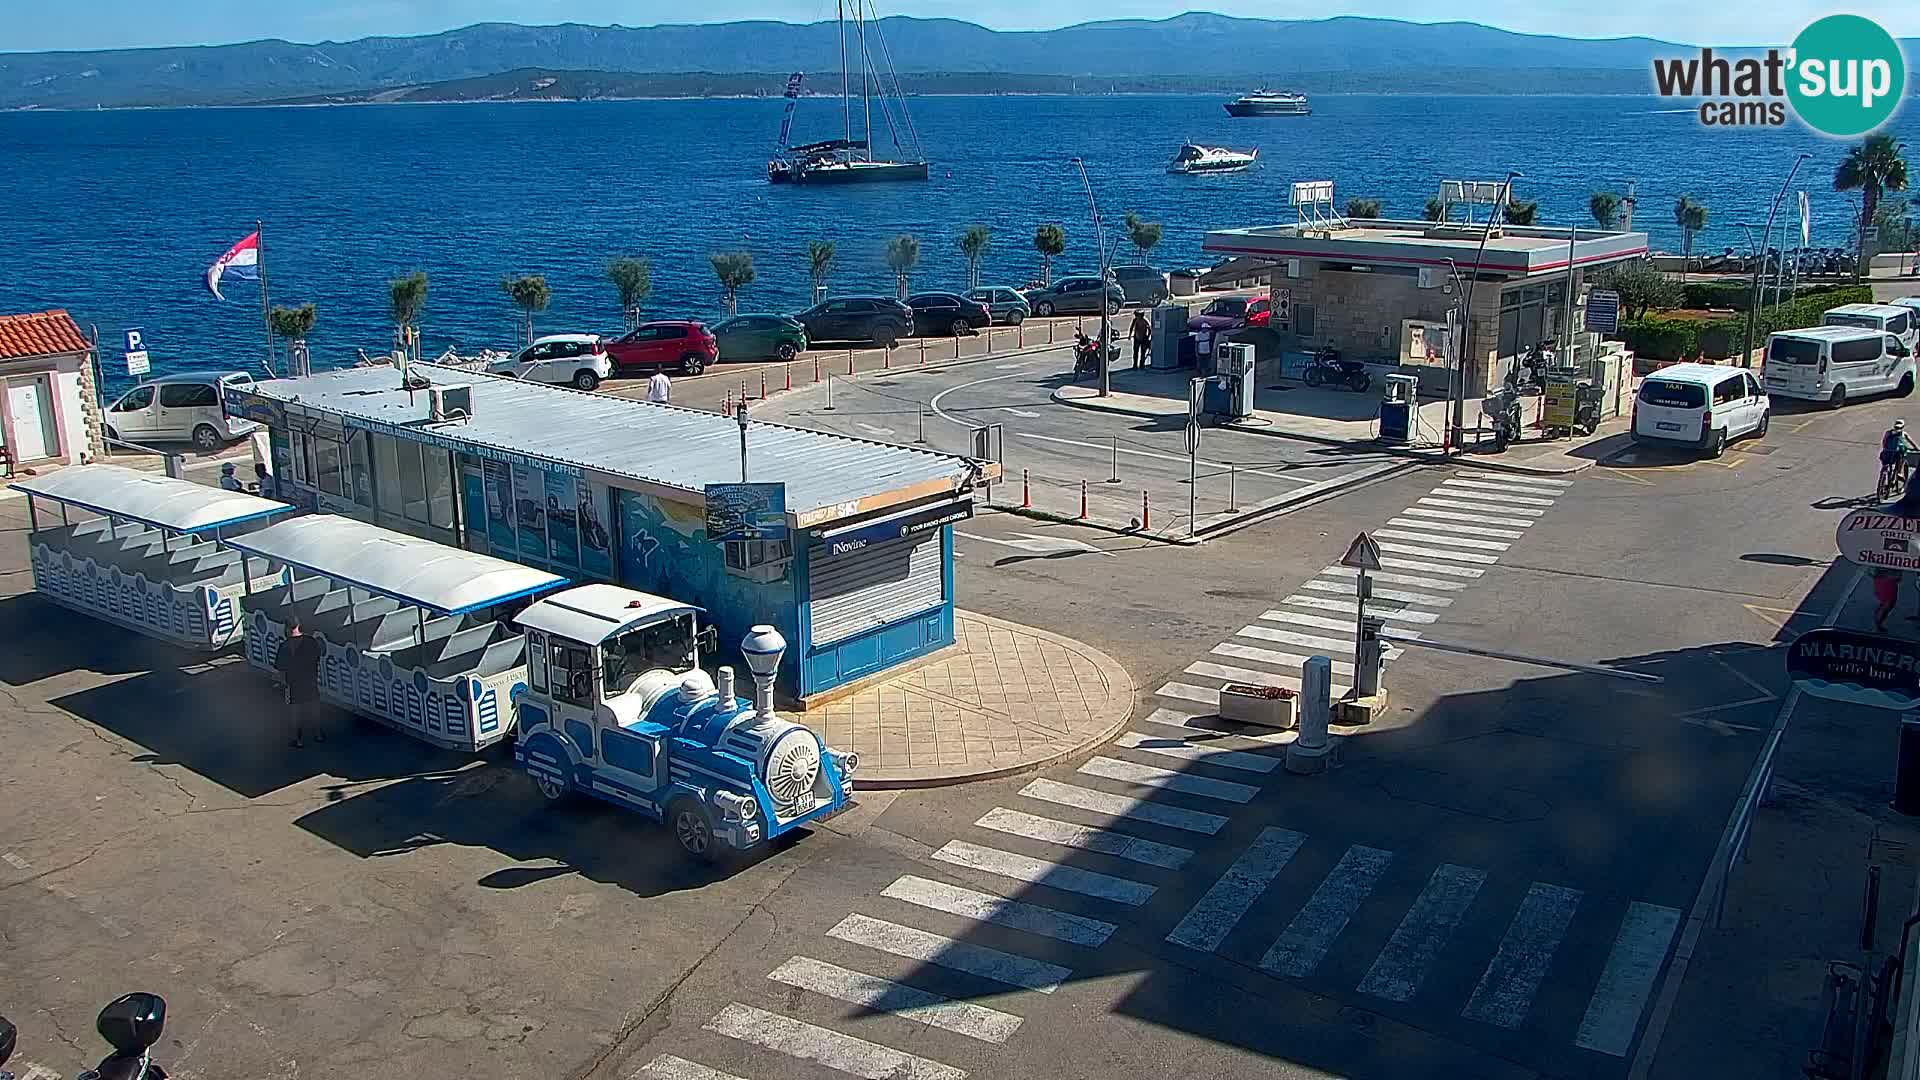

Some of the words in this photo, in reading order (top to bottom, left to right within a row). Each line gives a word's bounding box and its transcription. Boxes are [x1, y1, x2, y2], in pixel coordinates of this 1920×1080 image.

[128, 331, 141, 350] P
[394, 427, 434, 442] AUTOBUSNA
[435, 436, 466, 451] POSTAJA
[476, 445, 492, 458] BUS
[493, 448, 525, 465] STATION
[527, 457, 552, 471] TICKET
[554, 463, 581, 478] OFFICE
[1869, 664, 1896, 680] bar
